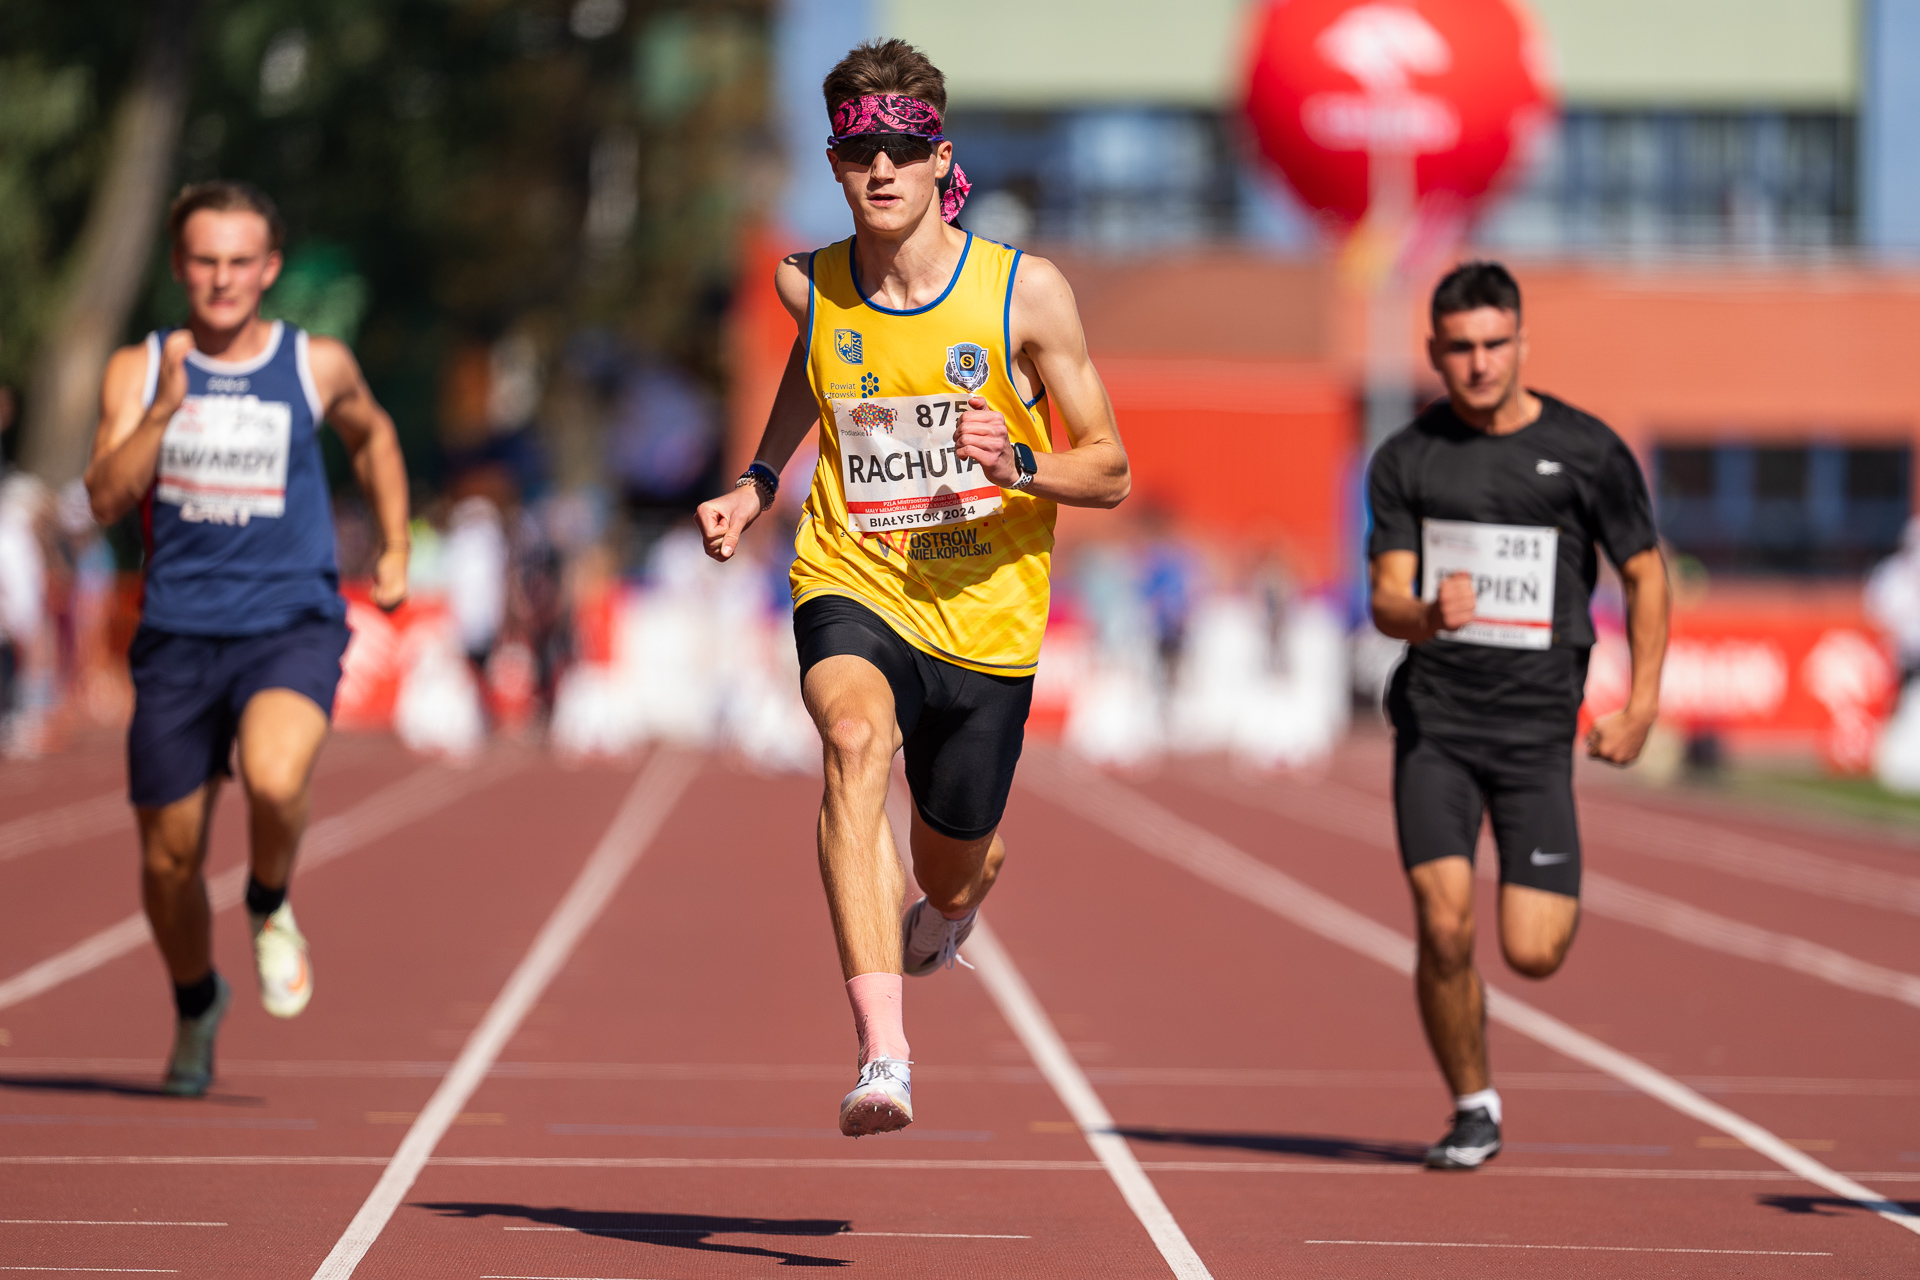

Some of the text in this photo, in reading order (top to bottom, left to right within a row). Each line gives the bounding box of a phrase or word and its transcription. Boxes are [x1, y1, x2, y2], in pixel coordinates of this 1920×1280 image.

[830, 382, 856, 390] Powiat
[841, 429, 866, 437] Podlaskie
[870, 505, 976, 527] BIAŁYSTOK 2024
[910, 527, 978, 549] OSTRÓW
[1497, 534, 1542, 560] 281
[907, 542, 992, 560] WIELKOPOLSKI
[1436, 567, 1540, 604] PIEŃ
